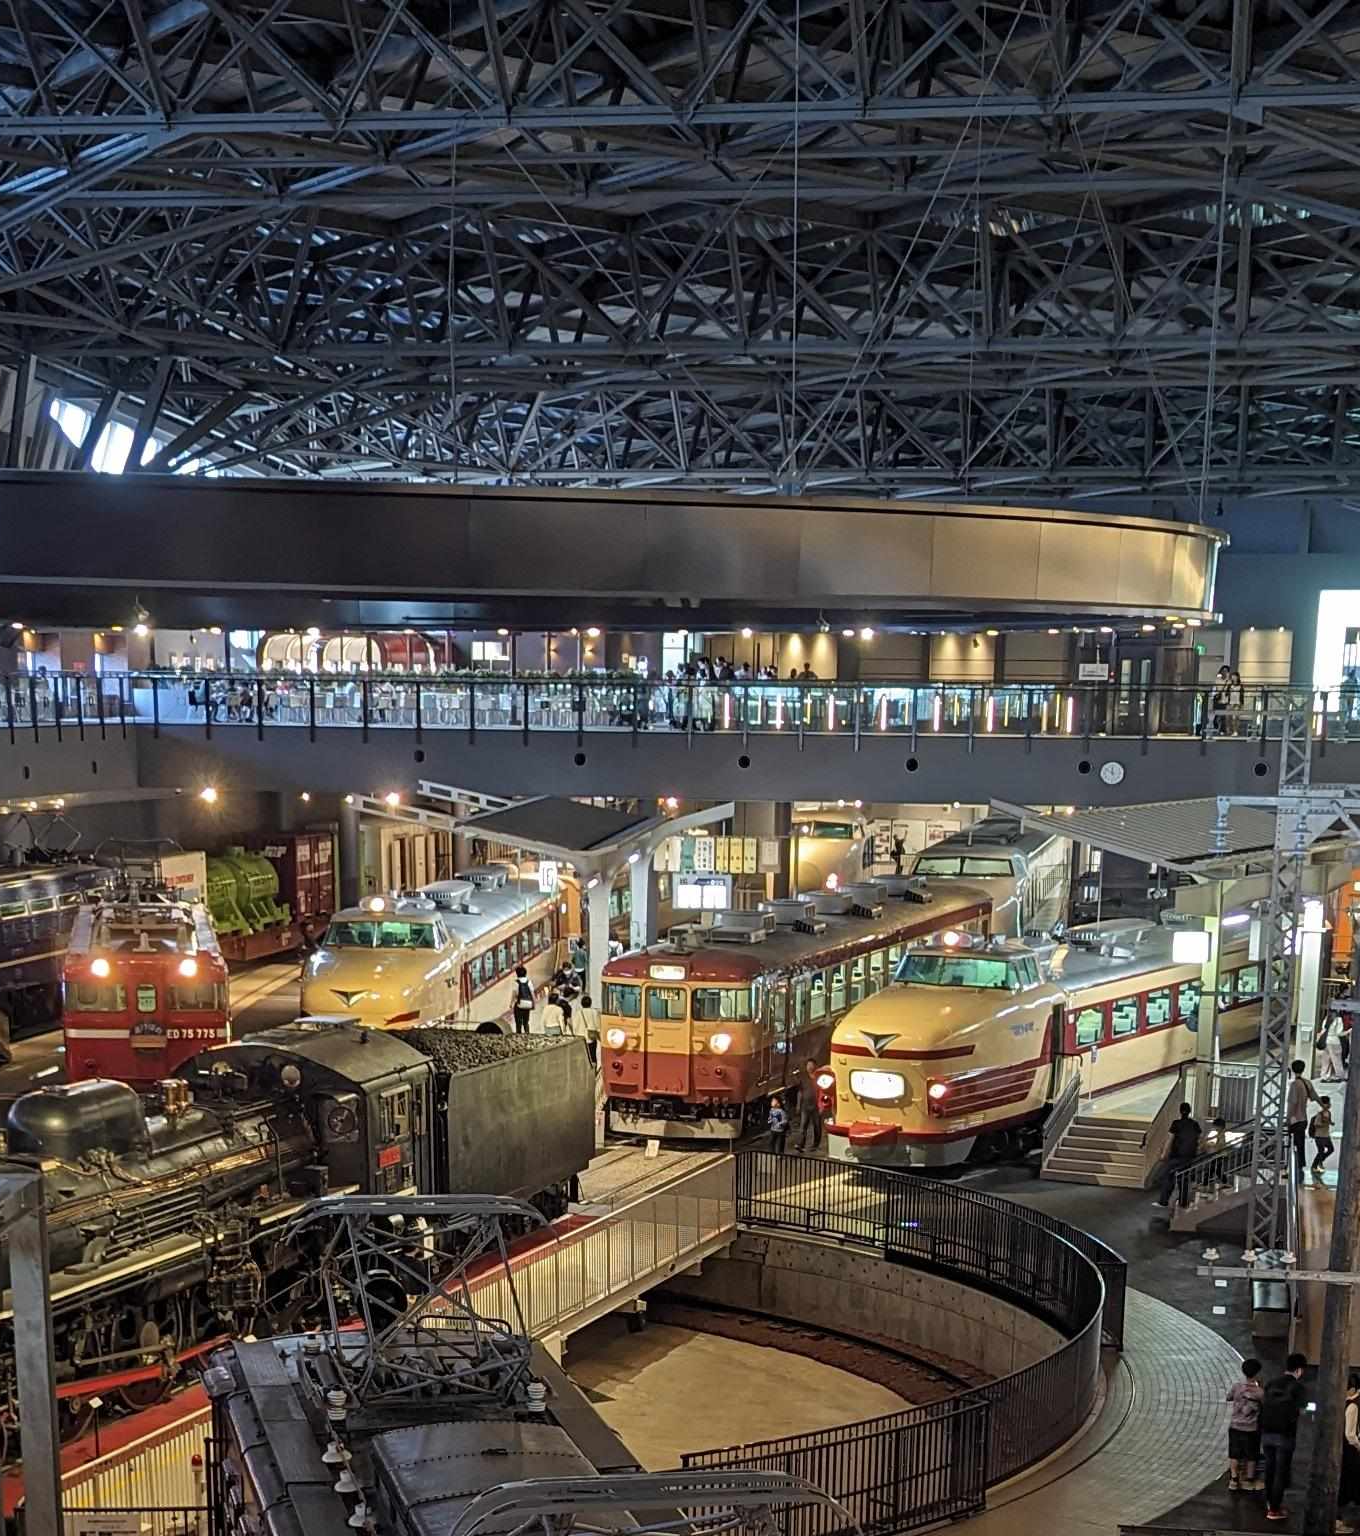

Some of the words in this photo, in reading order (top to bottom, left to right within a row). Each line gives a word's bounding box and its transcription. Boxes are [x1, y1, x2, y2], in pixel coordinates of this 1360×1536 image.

[166, 1029, 180, 1039] ED
[181, 1029, 194, 1039] 75
[195, 1029, 215, 1039] 775
